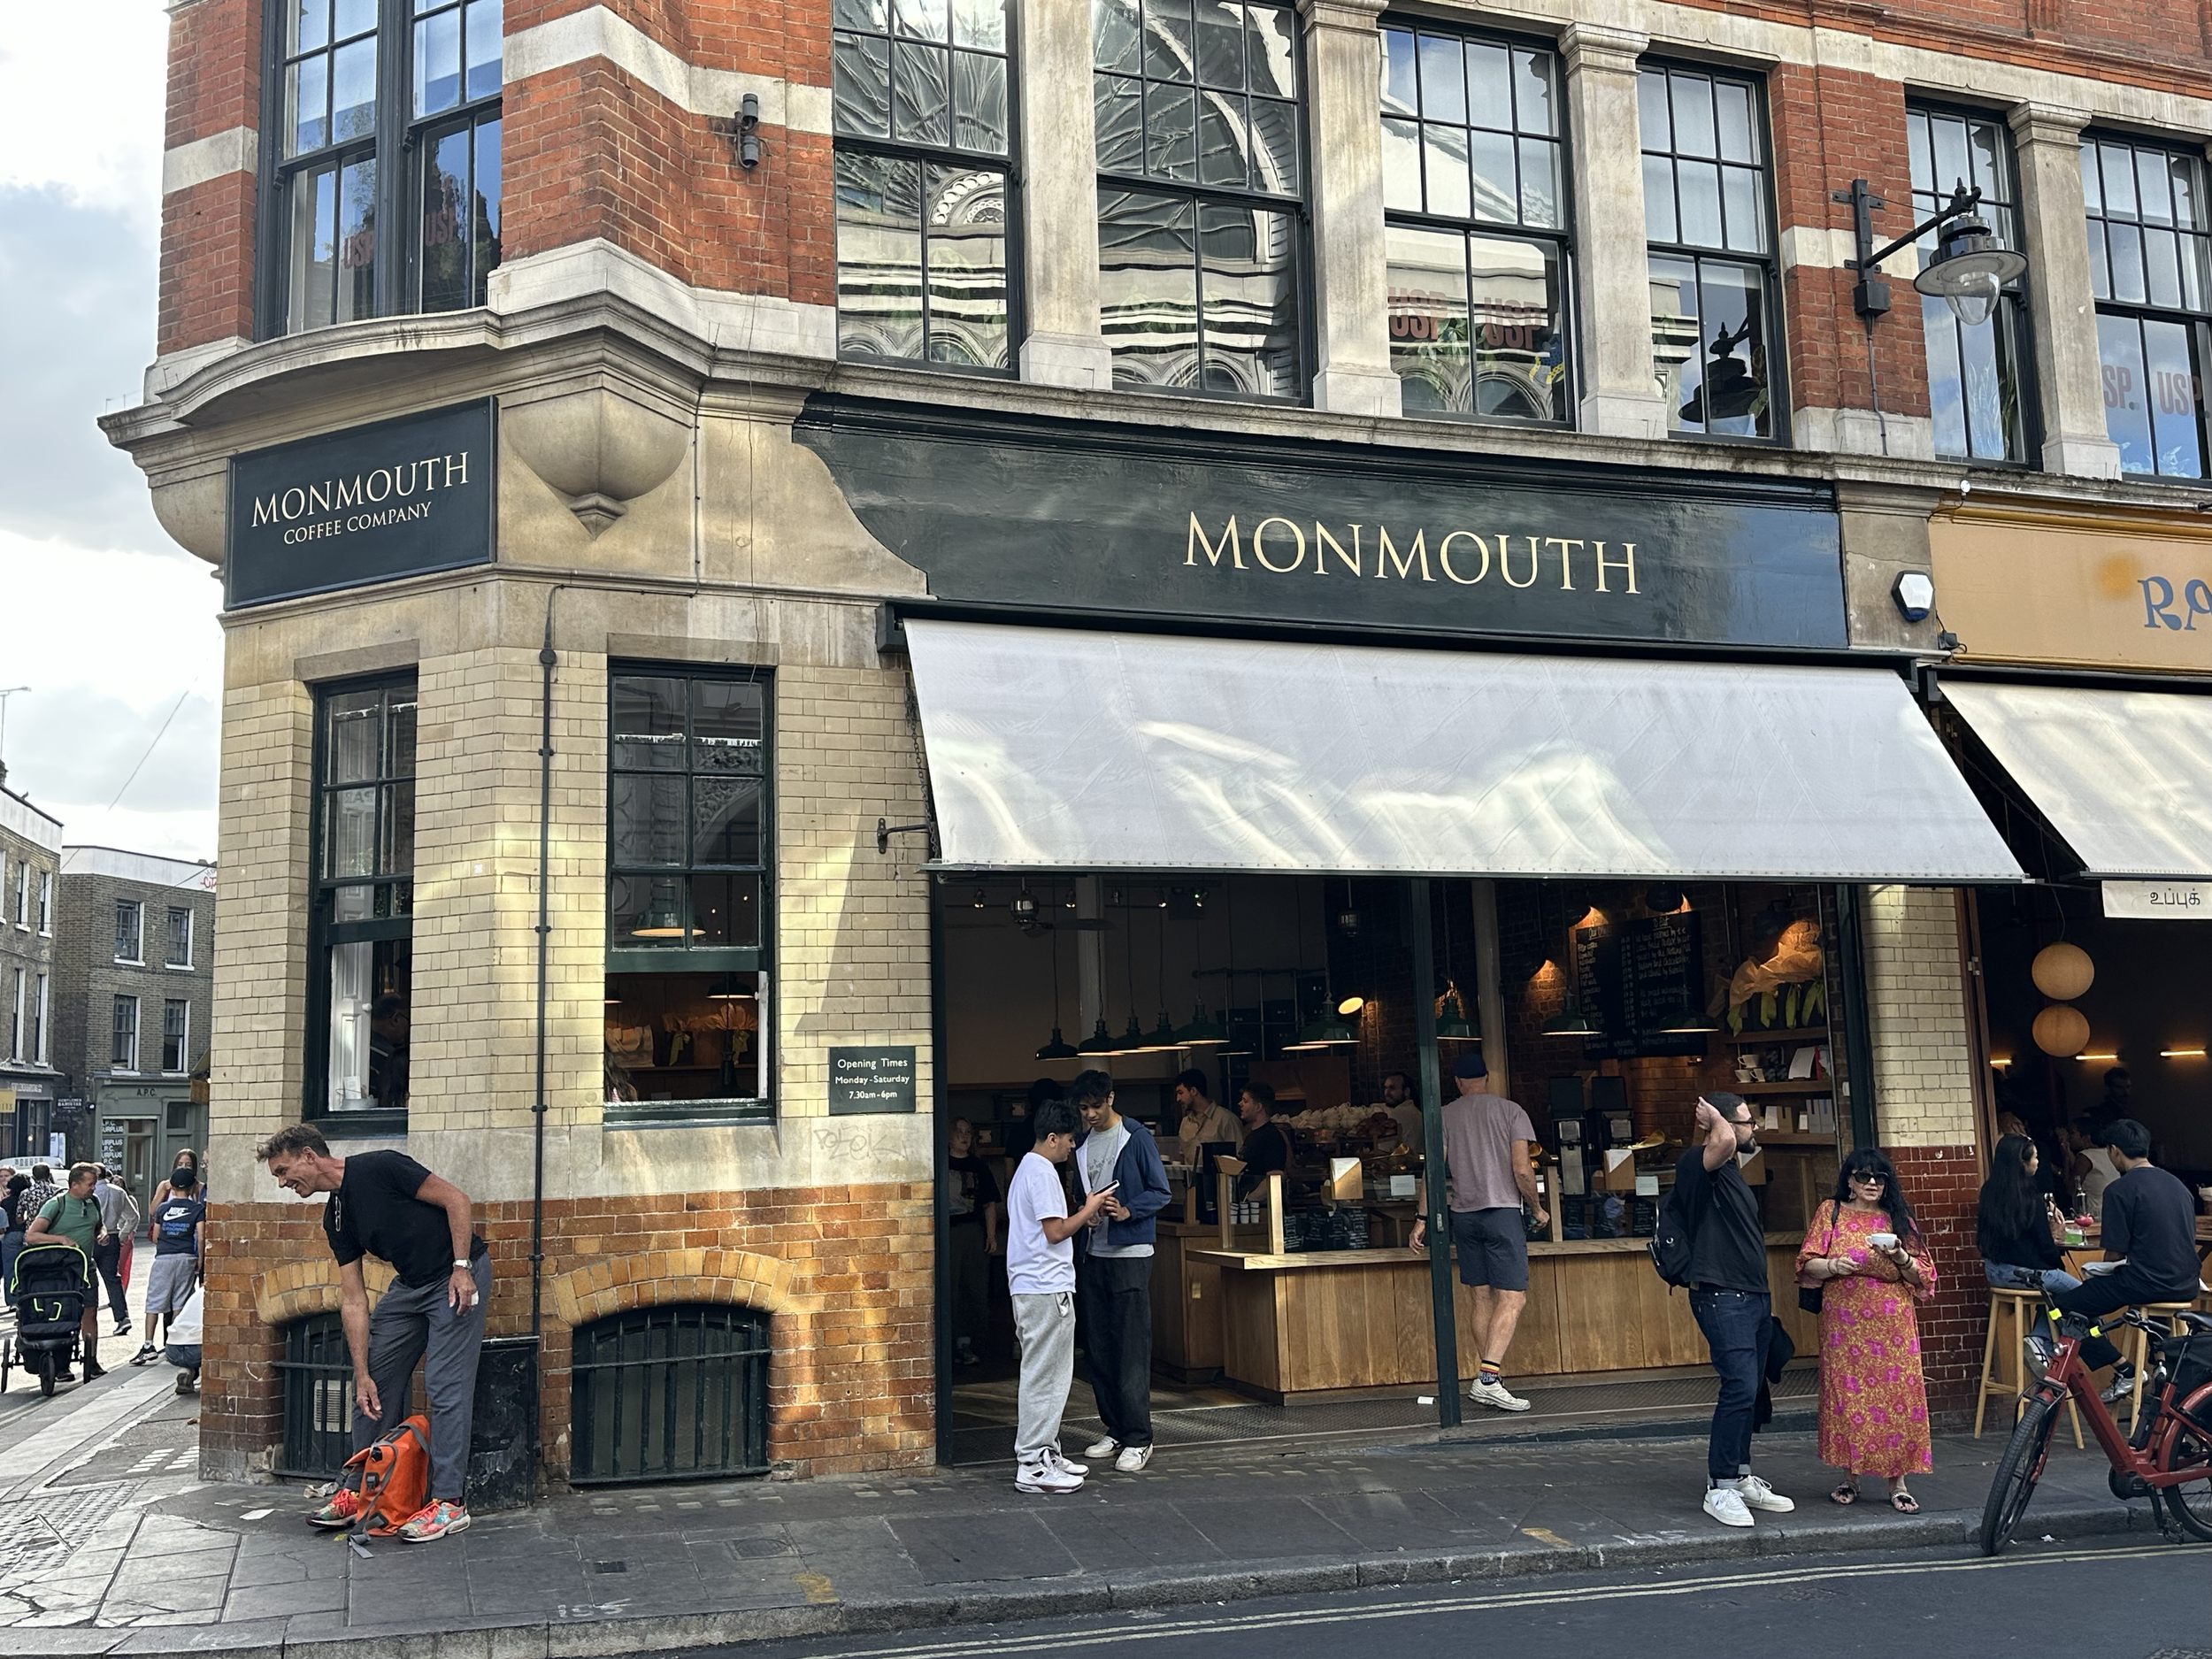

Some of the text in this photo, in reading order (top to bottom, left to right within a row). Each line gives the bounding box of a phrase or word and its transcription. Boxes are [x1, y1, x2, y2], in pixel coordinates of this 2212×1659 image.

[251, 451, 469, 527] MONMOUTH
[283, 501, 432, 545] COFFEE COMPANY
[1183, 511, 1641, 595] MONMOUTH
[837, 1057, 908, 1071] Opening Times
[136, 1087, 157, 1096] A.P.C.
